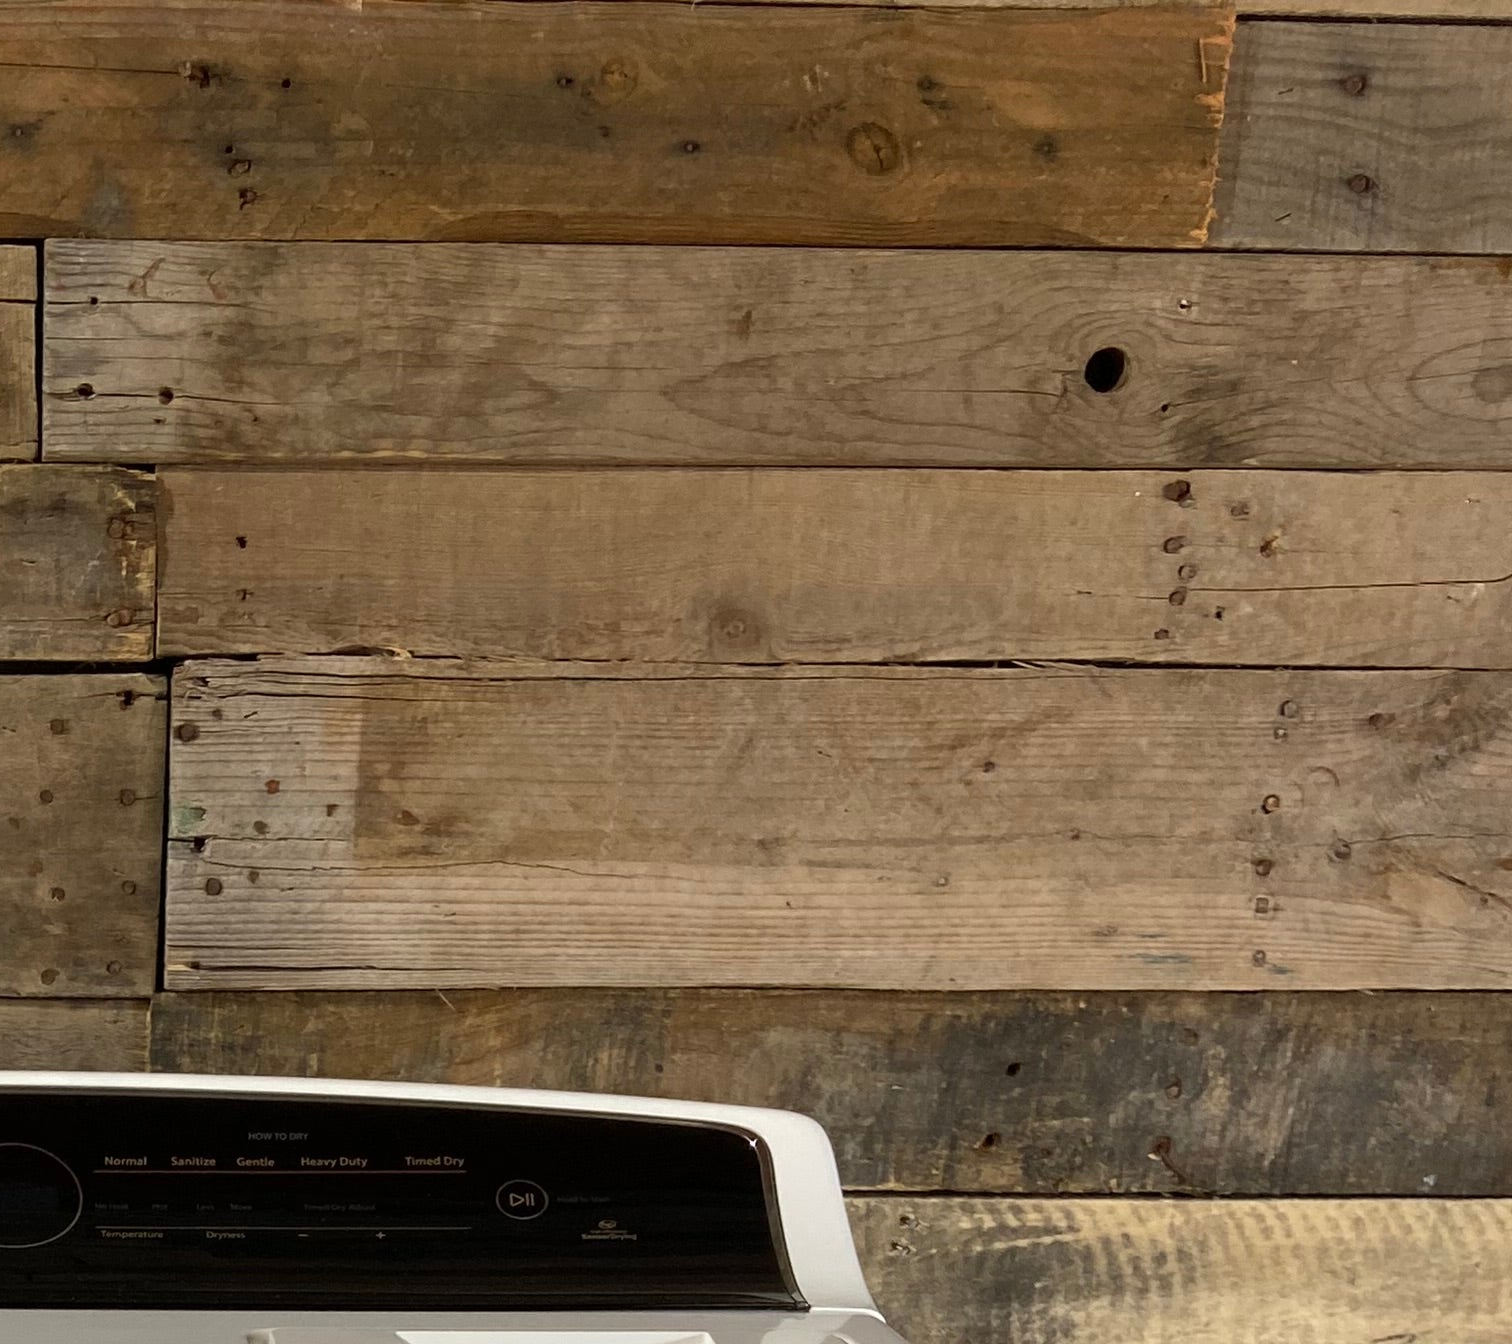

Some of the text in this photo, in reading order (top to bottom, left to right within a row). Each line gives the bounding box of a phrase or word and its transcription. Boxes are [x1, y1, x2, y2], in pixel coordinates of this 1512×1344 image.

[247, 1132, 309, 1141] HOW TO DRY
[104, 1156, 148, 1167] Normal
[171, 1156, 217, 1167] Sanitize
[236, 1156, 275, 1168] Gentle
[300, 1156, 368, 1168] Heavy Duty
[404, 1156, 465, 1168] Timed Dry
[101, 1229, 164, 1240] Temperature
[206, 1229, 246, 1241] Dryness
